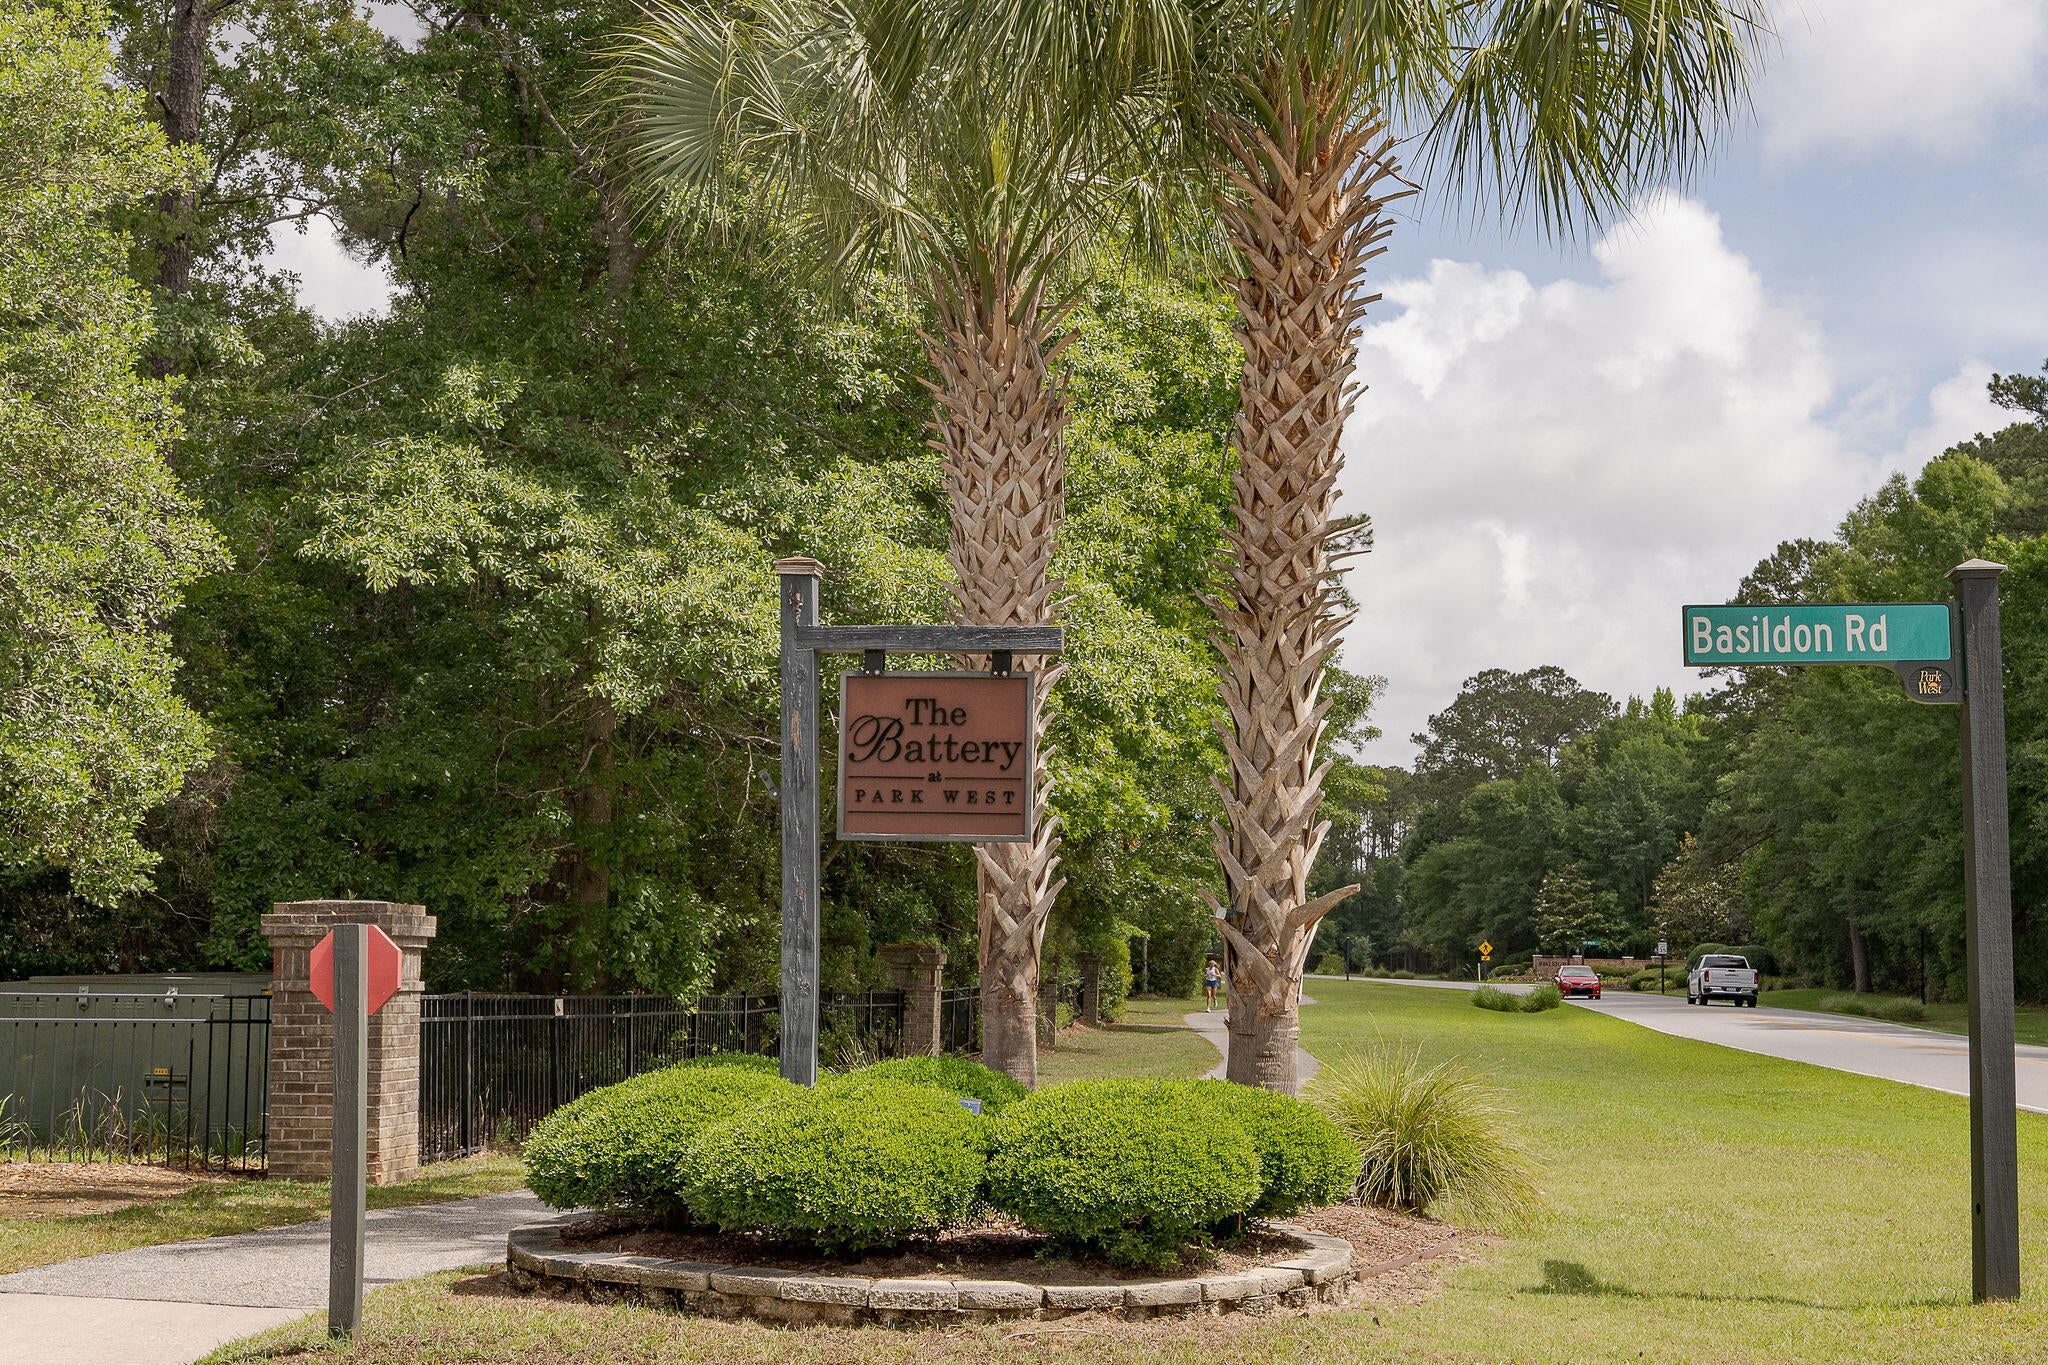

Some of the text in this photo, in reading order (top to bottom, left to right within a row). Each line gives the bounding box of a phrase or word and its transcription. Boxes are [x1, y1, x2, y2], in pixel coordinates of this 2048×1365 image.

[1692, 613, 1888, 654] Basildon Rd
[1920, 670, 1942, 682] Park
[1918, 681, 1942, 695] West
[905, 698, 967, 726] The
[848, 714, 1023, 770] Battery
[927, 769, 943, 782] at
[855, 789, 1015, 804] PARK WEST
